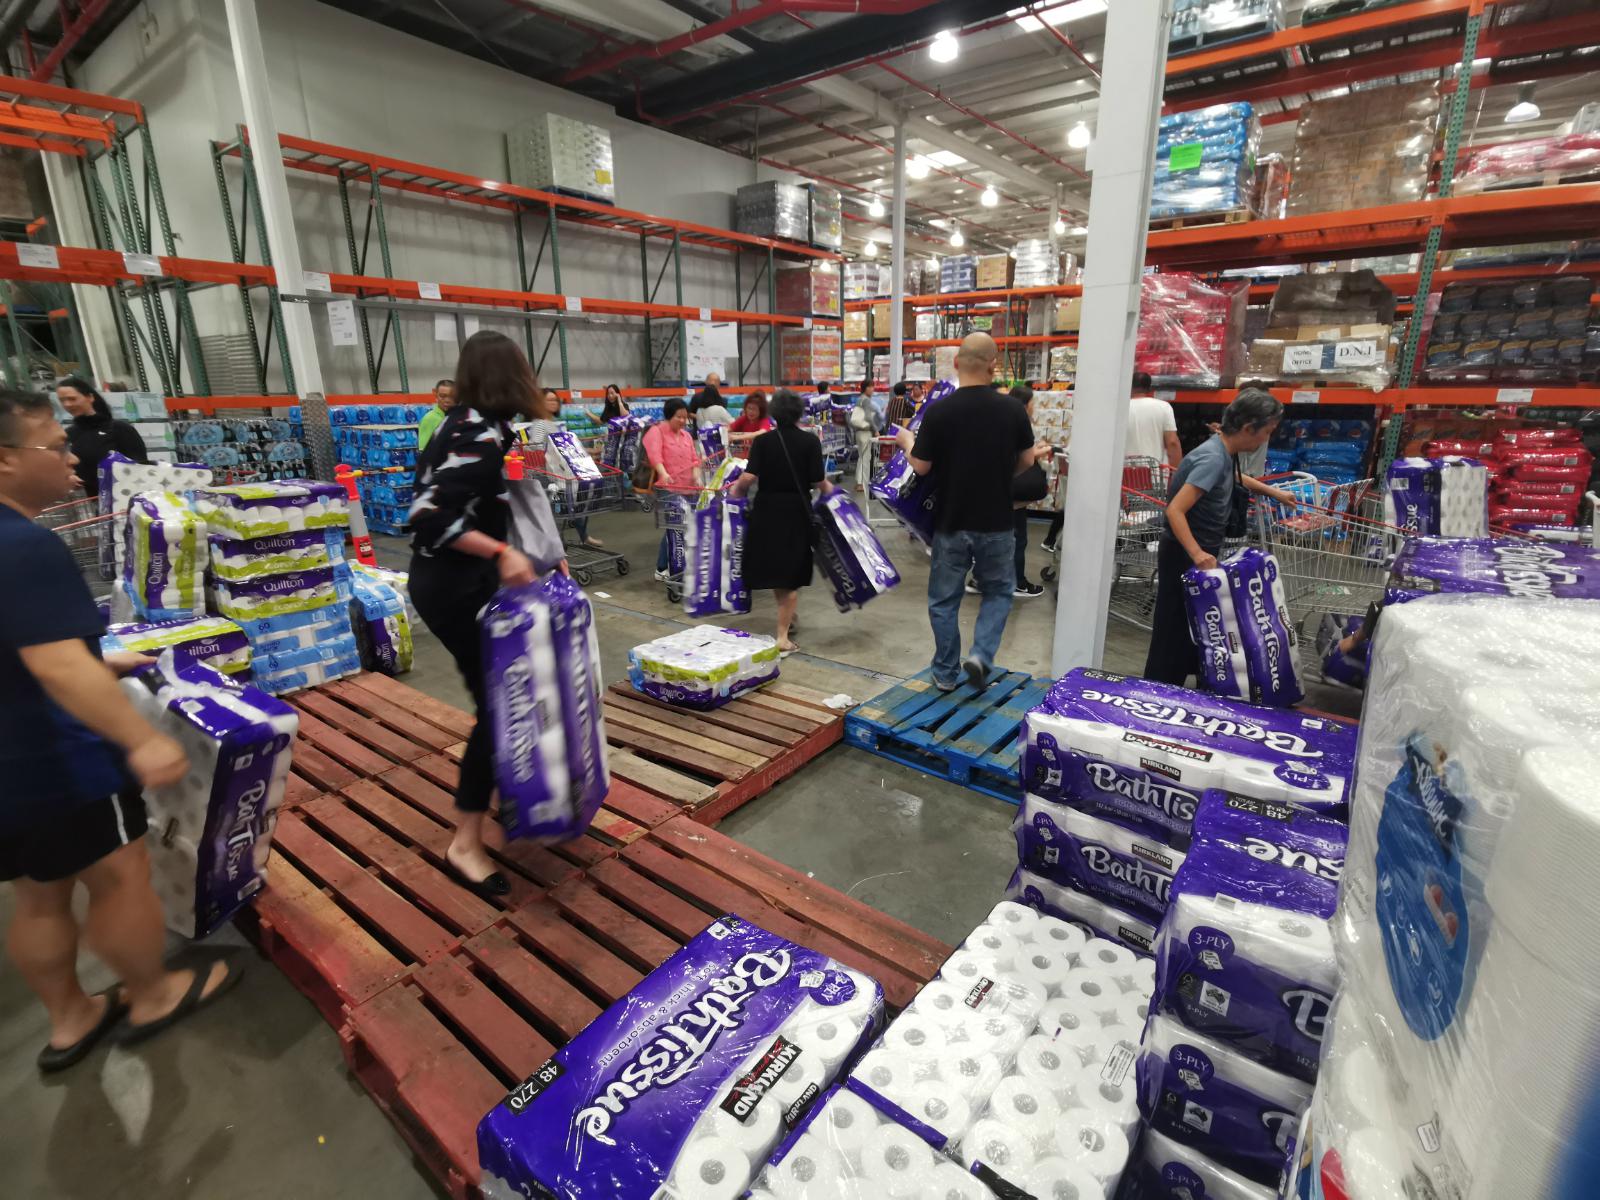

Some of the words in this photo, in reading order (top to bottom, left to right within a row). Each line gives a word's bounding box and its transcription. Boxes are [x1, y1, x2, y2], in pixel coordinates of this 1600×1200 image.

[254, 539, 296, 551] Quilton
[148, 552, 164, 585] Quilton
[263, 577, 305, 593] Quilton
[1124, 733, 1207, 761] KIRKLAND
[1142, 758, 1180, 777] KIRKLAND
[1228, 799, 1260, 812] 270
[1265, 810, 1287, 820] 48
[1133, 845, 1173, 866] KIRKLAND
[1193, 932, 1231, 951] 3-PLY
[599, 1014, 659, 1069] absorbent
[1174, 1048, 1210, 1073] 3-PLY
[539, 1065, 558, 1083] 48
[510, 1081, 540, 1109] 270
